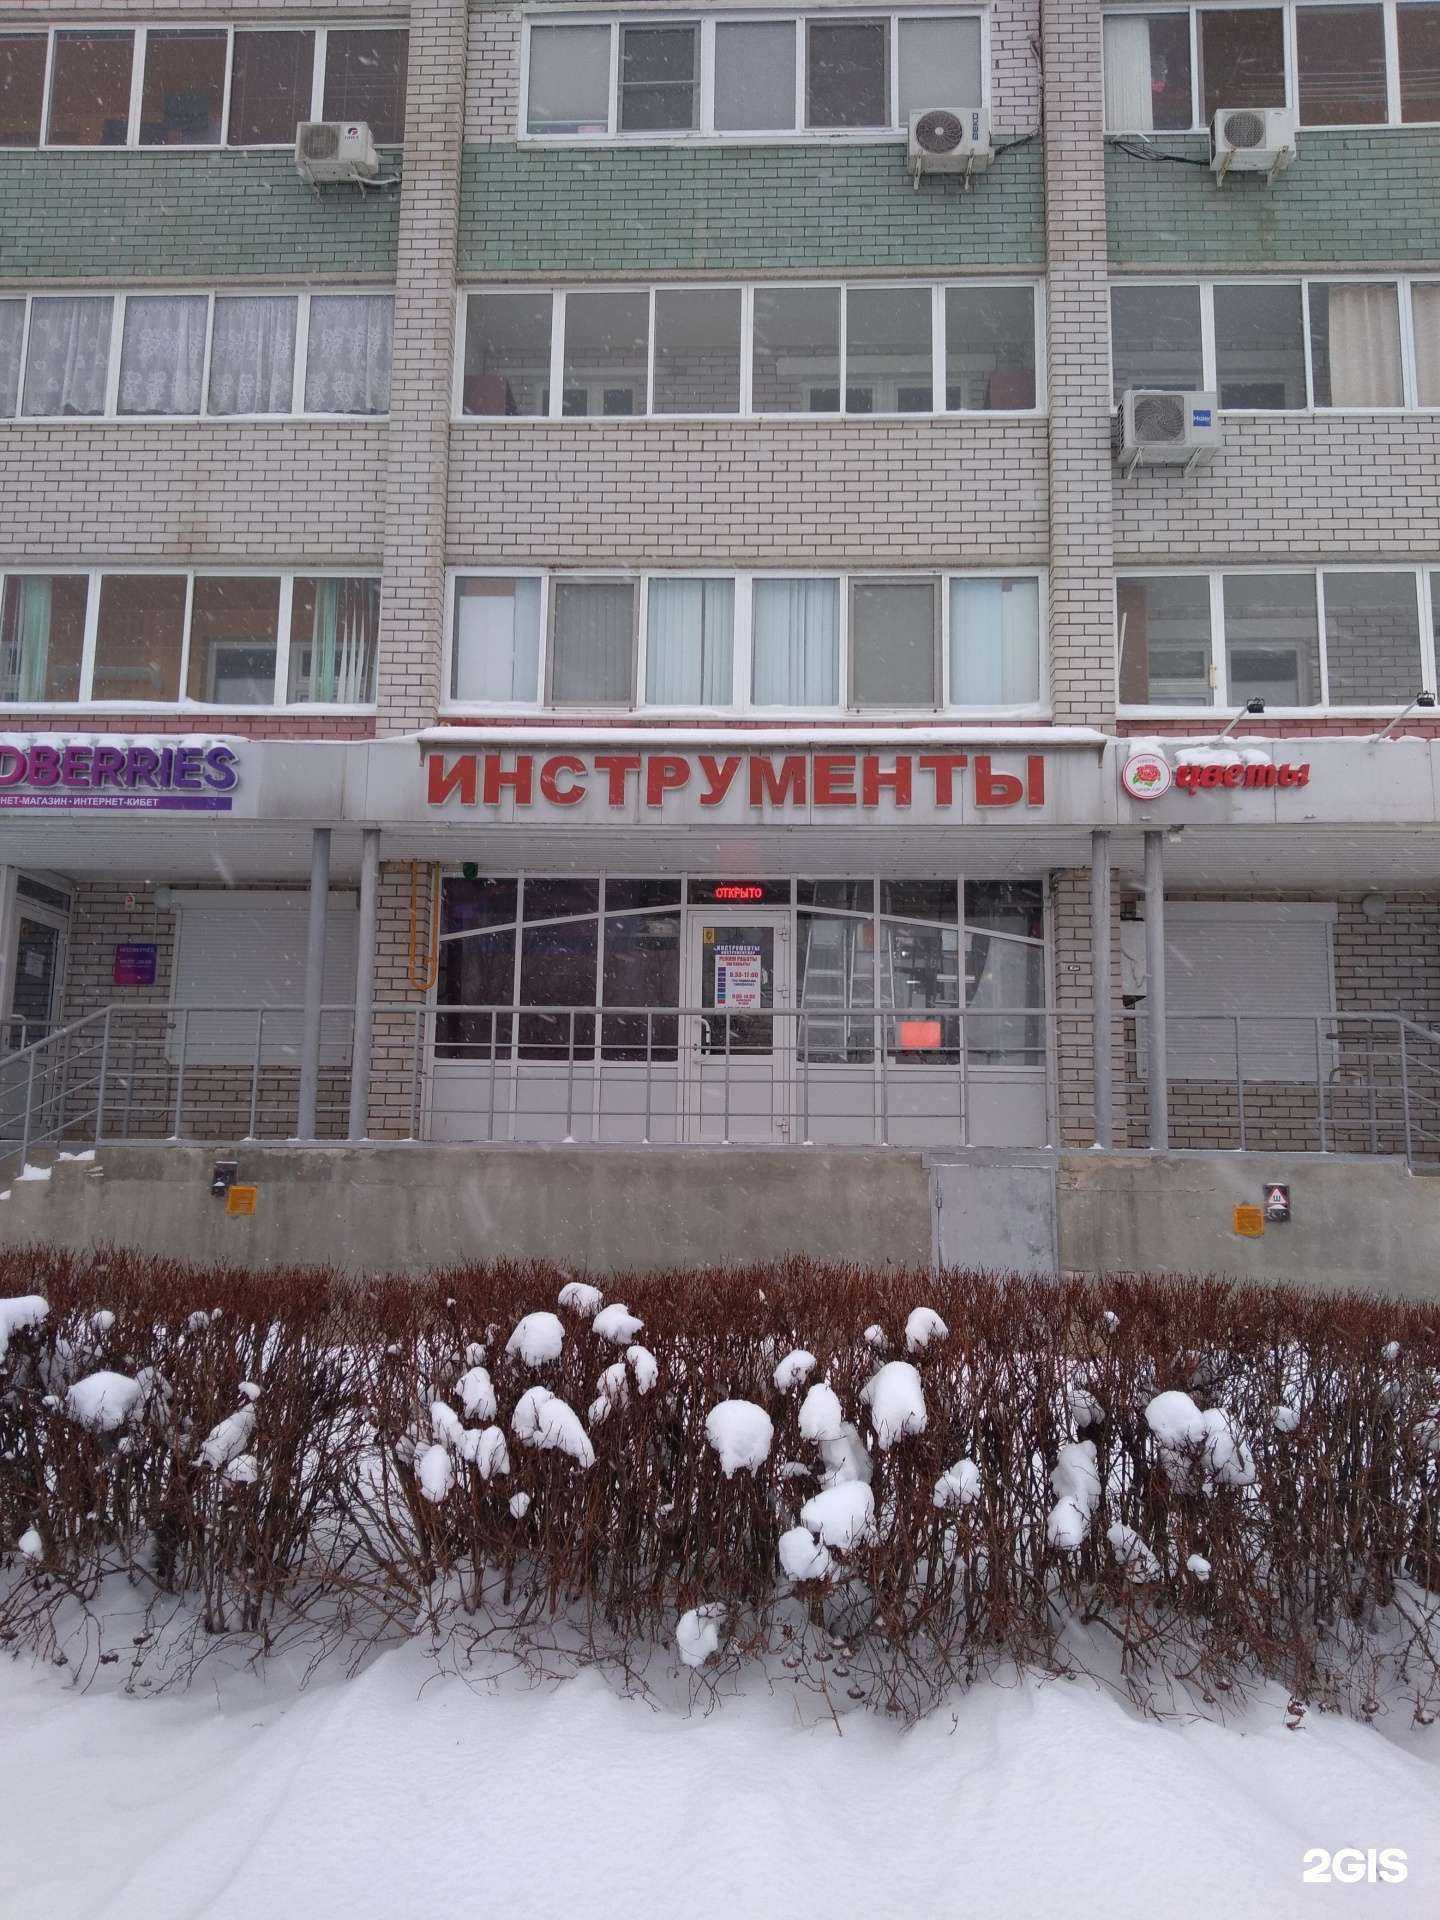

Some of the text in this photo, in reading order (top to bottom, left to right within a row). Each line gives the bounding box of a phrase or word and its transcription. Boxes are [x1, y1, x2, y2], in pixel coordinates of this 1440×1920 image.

[427, 754, 1045, 807] ИНСТРУМЕНТЫ
[1174, 762, 1311, 796] цветы
[73, 797, 160, 807] ИНТЕРНЕТ-КИБЕТ
[714, 887, 763, 899] ОТКРЫТО
